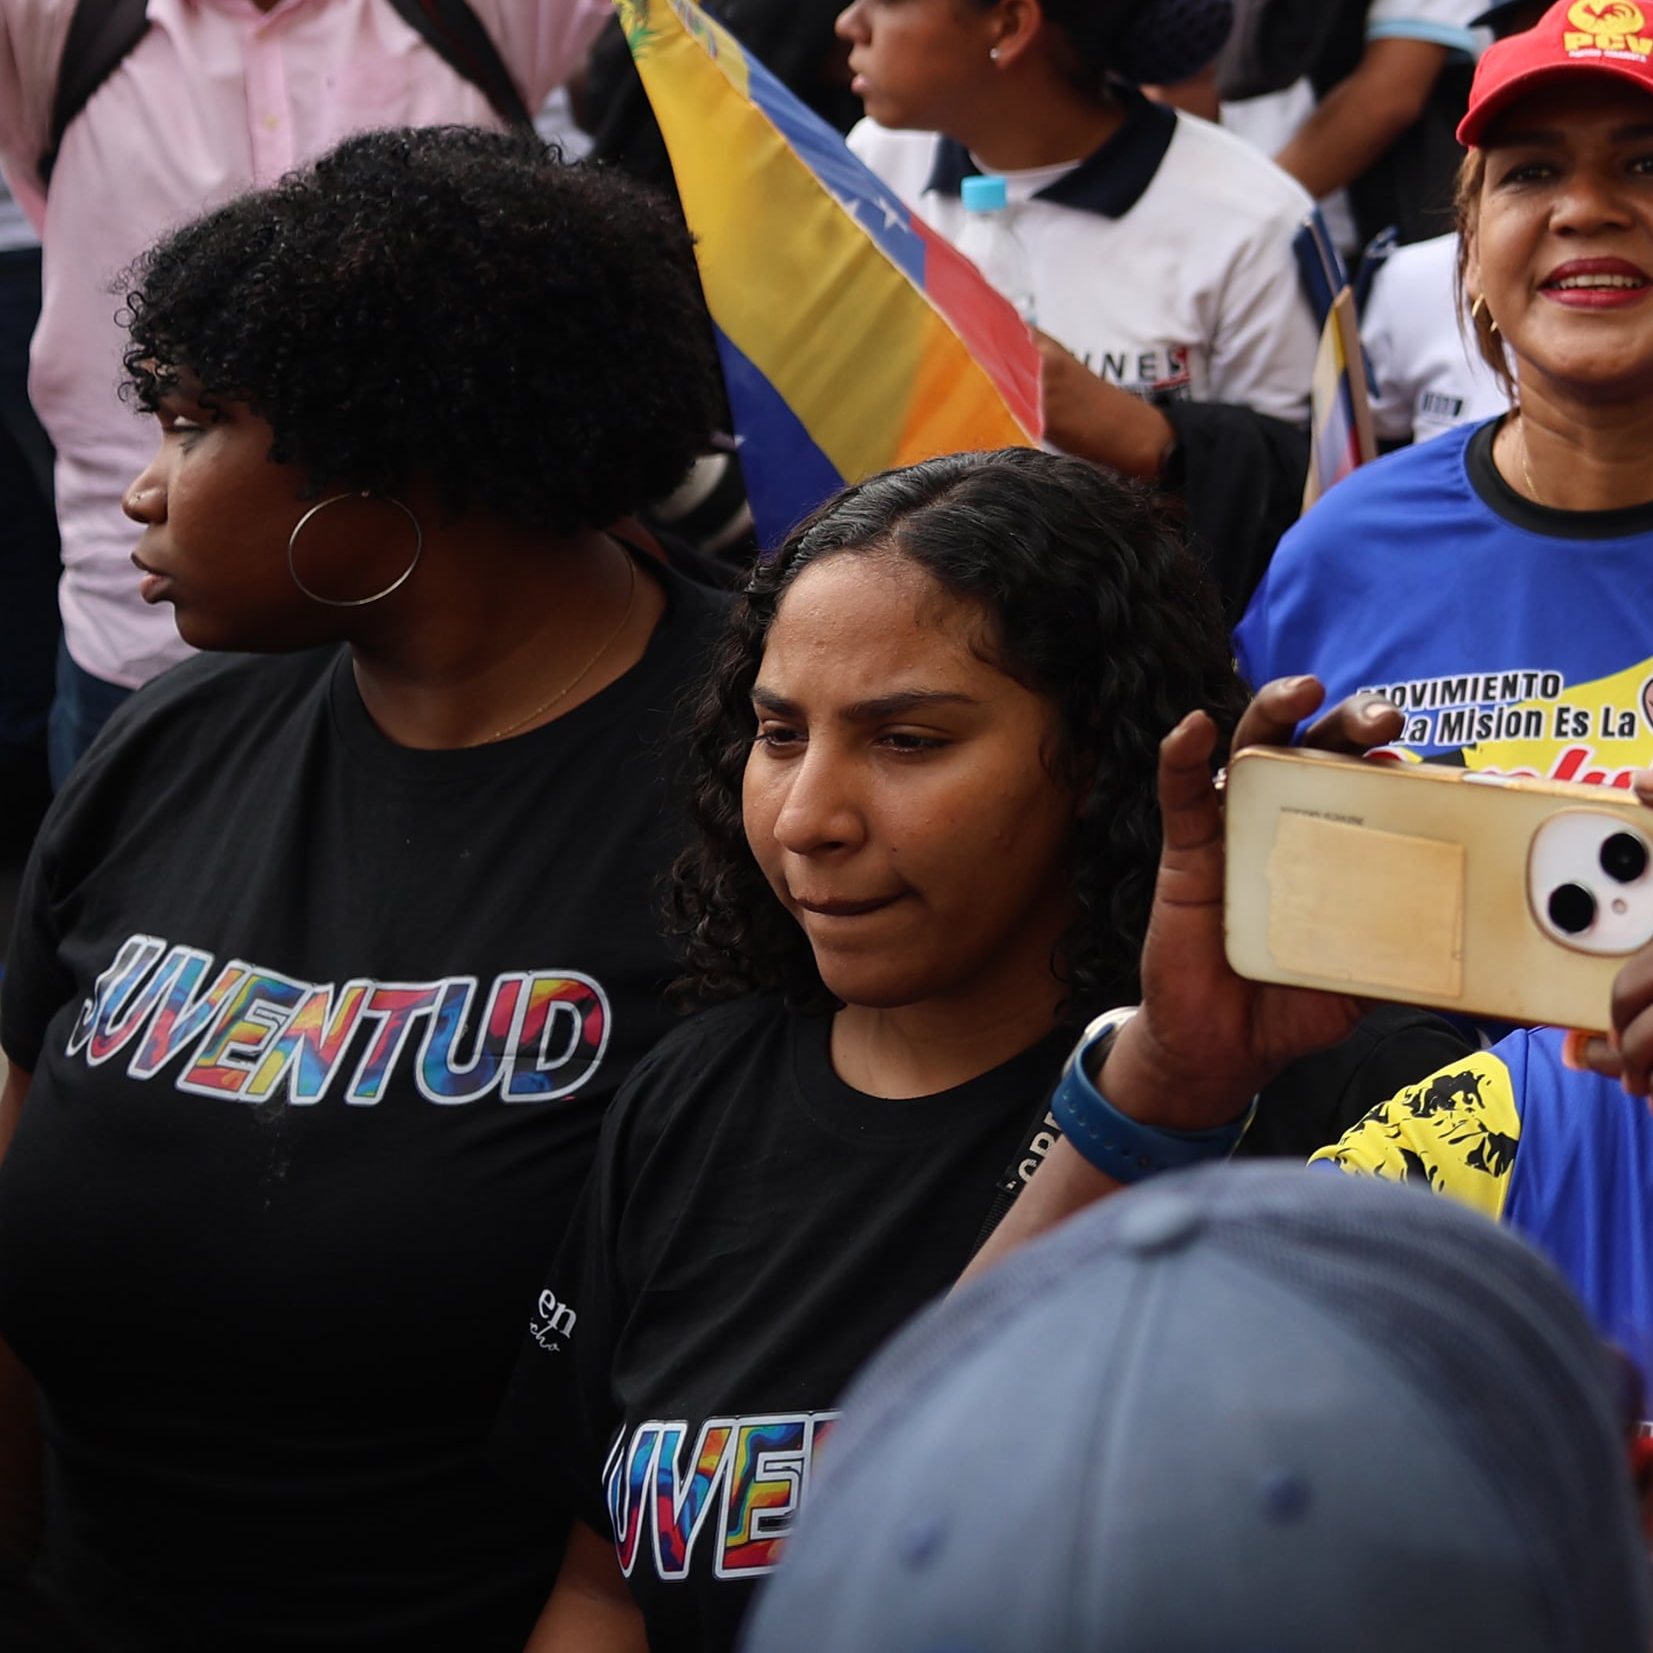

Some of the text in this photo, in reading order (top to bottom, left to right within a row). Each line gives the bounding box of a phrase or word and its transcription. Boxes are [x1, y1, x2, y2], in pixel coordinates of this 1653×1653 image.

[1358, 673, 1561, 709] OVIMIENTO
[1555, 706, 1590, 739] Es
[1601, 706, 1636, 740] La
[65, 932, 613, 1107] JUVENTUD
